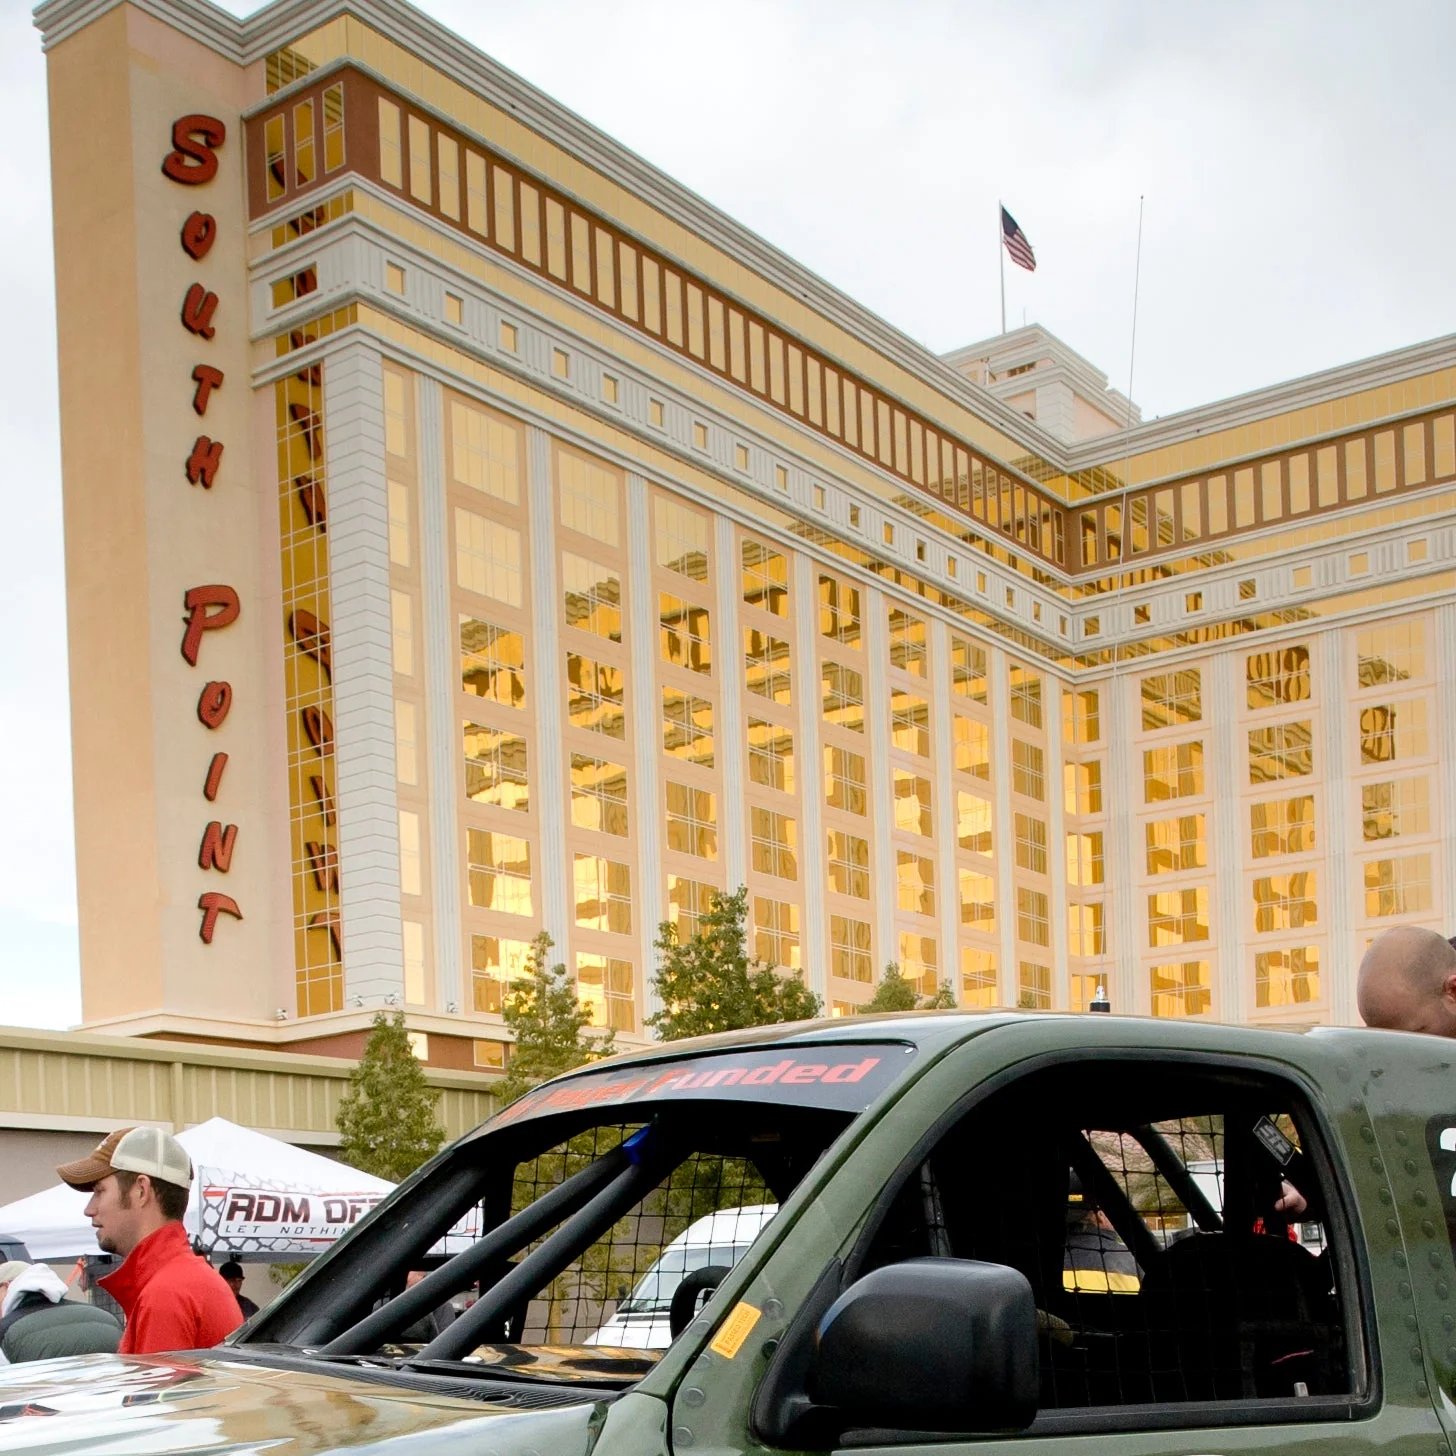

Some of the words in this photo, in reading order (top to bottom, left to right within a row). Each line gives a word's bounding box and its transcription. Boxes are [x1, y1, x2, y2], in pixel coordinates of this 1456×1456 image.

[161, 113, 226, 489] SOUTH
[181, 585, 242, 946] POINT
[647, 1058, 881, 1095] Funded
[225, 1225, 260, 1234] LET
